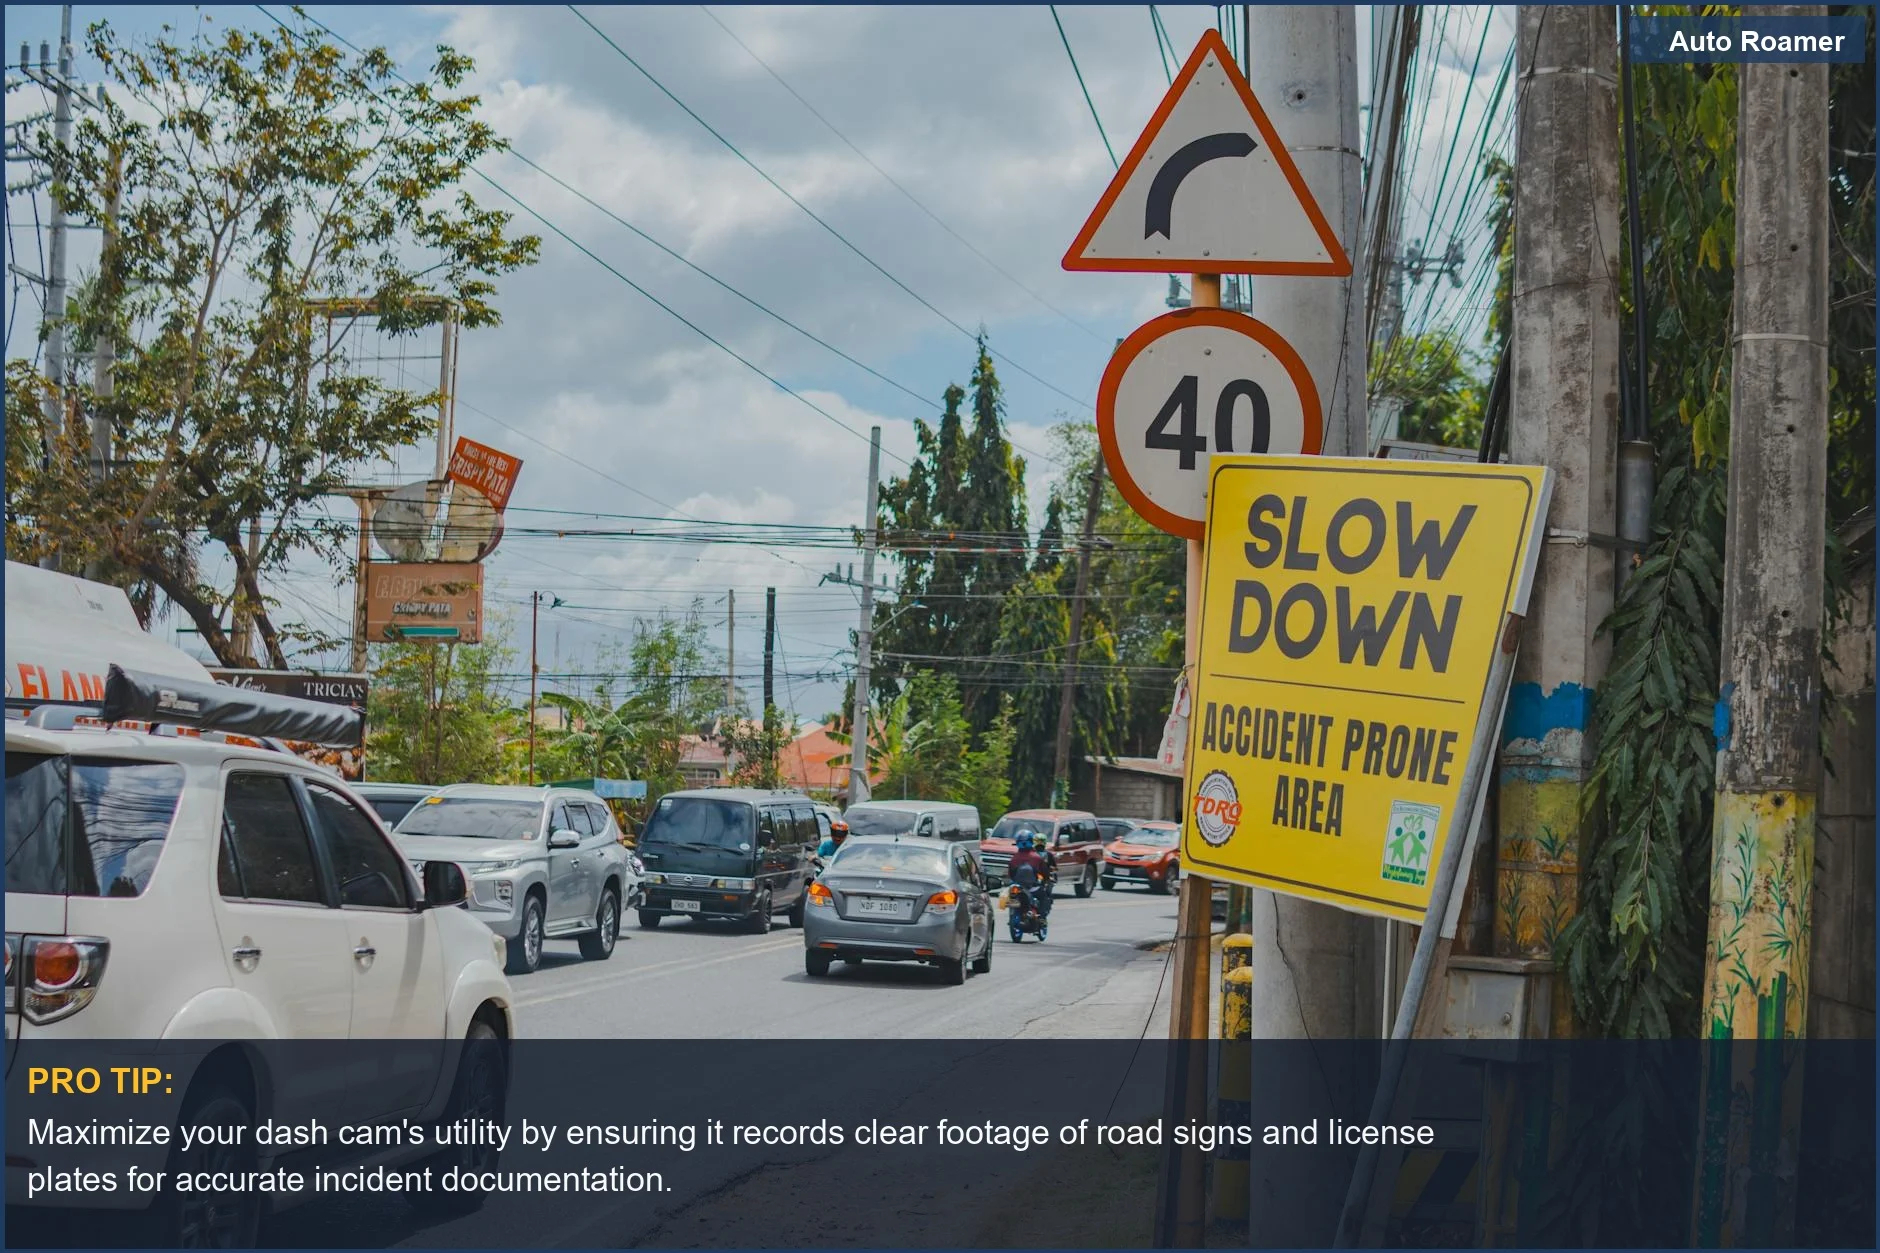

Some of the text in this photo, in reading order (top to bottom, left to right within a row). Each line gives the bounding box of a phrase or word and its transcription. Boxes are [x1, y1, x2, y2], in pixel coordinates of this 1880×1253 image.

[1145, 376, 1270, 470] 40
[449, 451, 509, 496] CRISPY PATA
[1244, 494, 1477, 580] SLOW
[1228, 580, 1462, 673] DOWN
[303, 681, 365, 698] TRICIA'S
[1202, 702, 1333, 768] ACCIDENT
[1342, 719, 1459, 785] PRONE
[1193, 795, 1243, 826] TDRO
[1272, 775, 1344, 836] AREA
